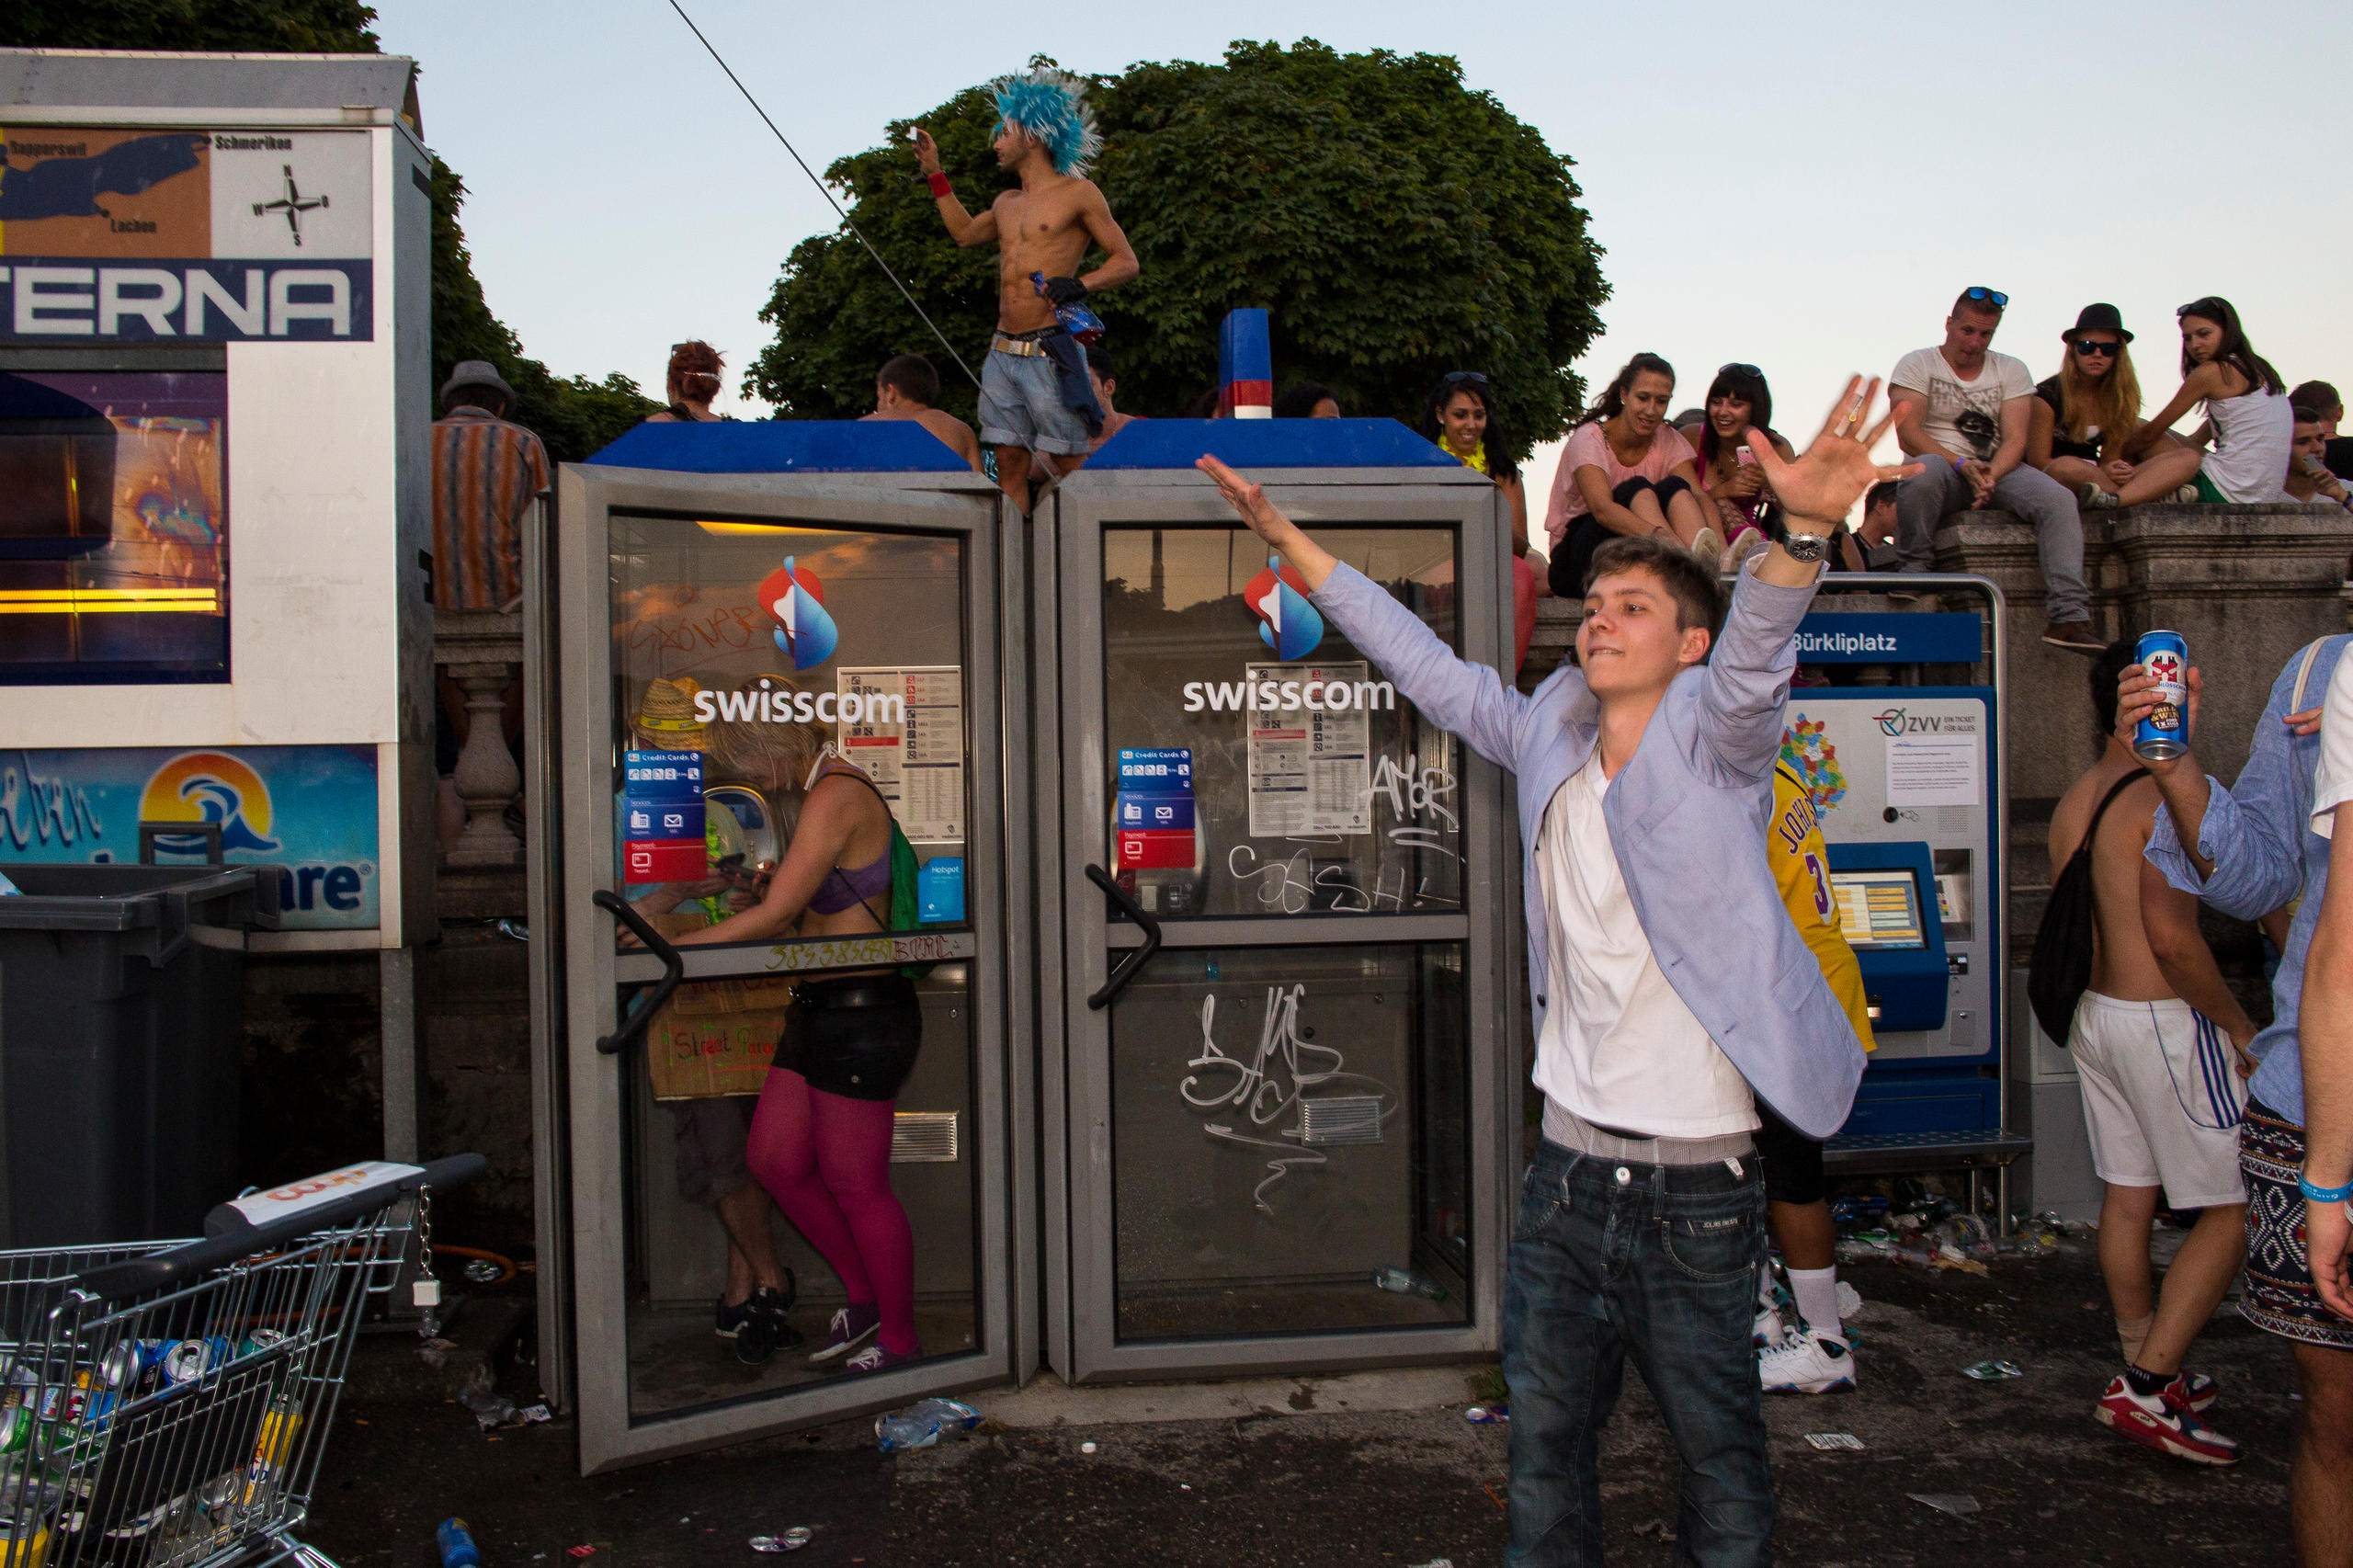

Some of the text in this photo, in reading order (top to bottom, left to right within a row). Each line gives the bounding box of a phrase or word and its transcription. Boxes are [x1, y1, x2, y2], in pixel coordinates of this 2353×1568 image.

[214, 135, 292, 151] Schmeriken
[110, 218, 157, 233] Lachen
[0, 265, 352, 337] ERNA
[1792, 631, 1898, 655] Bürkliplatz
[694, 677, 906, 723] swisscom
[1183, 669, 1395, 713] swisscom
[1908, 717, 1941, 733] ZVV
[931, 866, 961, 875] Hotspot
[267, 1169, 369, 1202] coop
